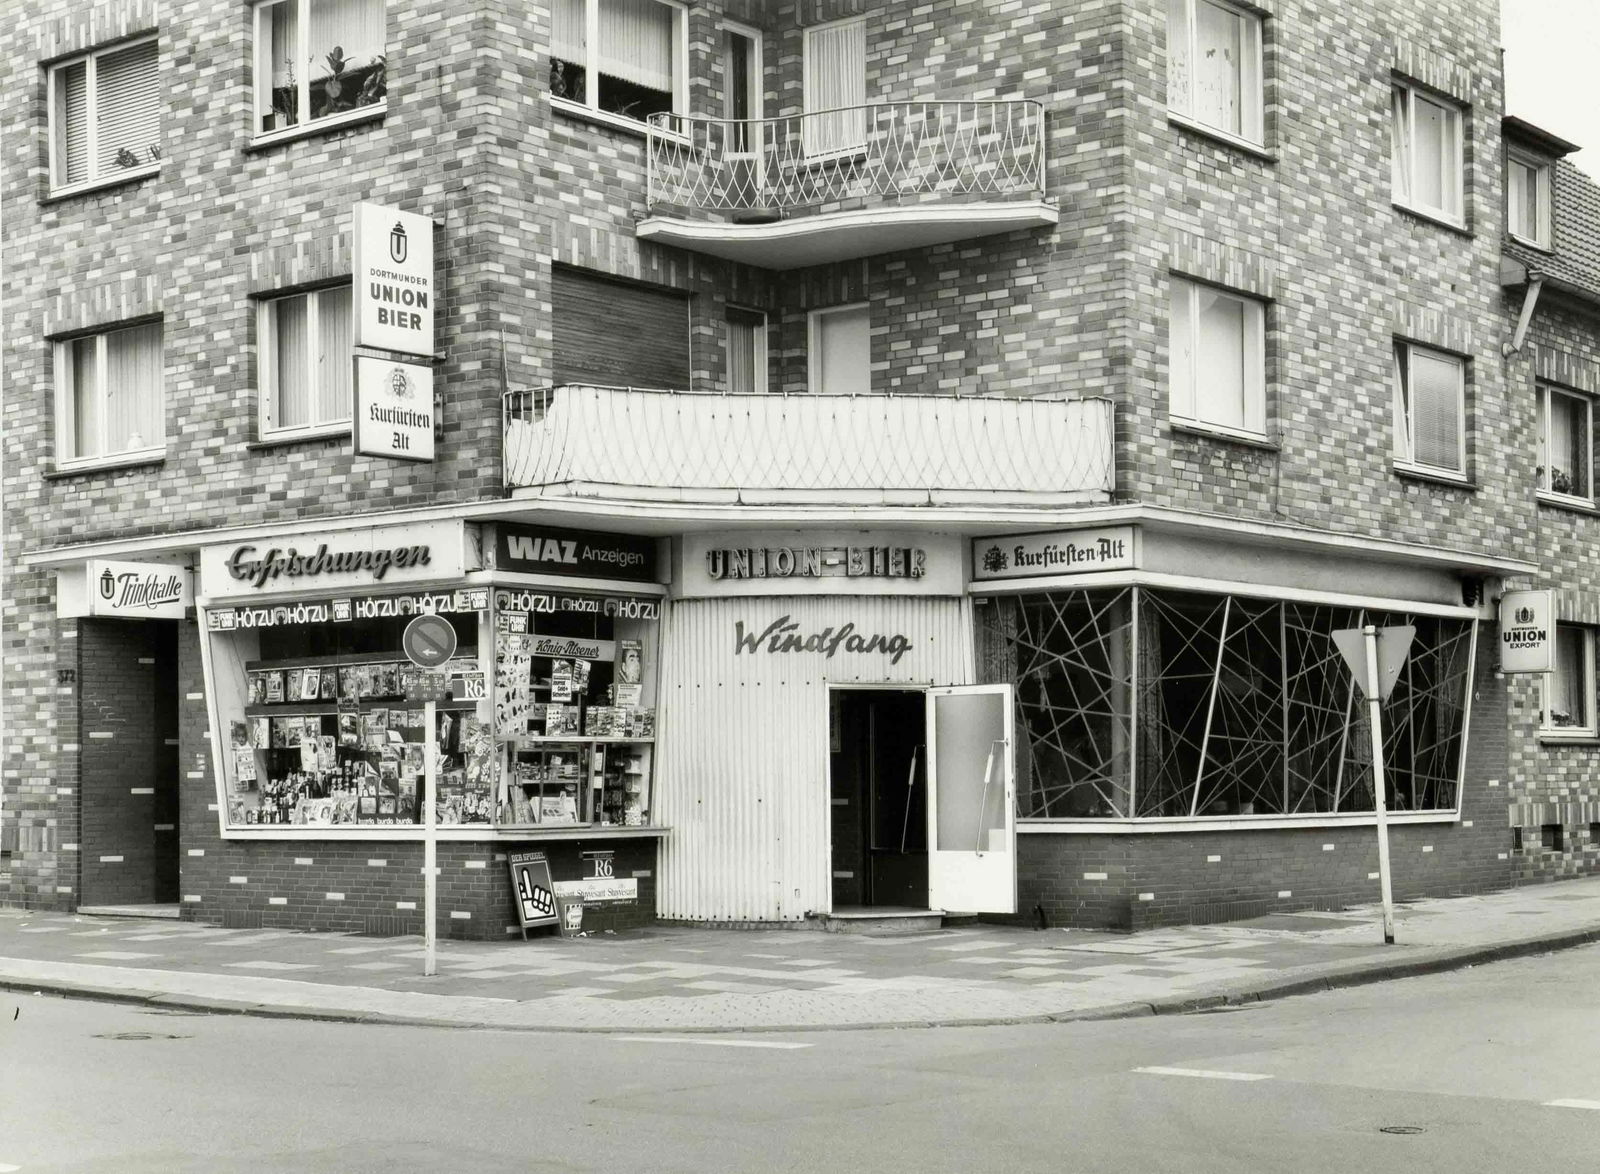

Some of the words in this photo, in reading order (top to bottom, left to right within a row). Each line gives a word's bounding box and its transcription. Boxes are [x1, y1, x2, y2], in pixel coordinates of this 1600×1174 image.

[370, 268, 428, 286] DORTMUNDER
[370, 282, 428, 309] UNION
[378, 307, 422, 331] BIER
[392, 431, 410, 451] Alt
[507, 535, 578, 564] WAZ
[582, 545, 644, 567] Anzeigen
[1097, 537, 1124, 562] Alt
[224, 544, 432, 588] Erfrischungen
[112, 573, 183, 609] Trinkhalle
[509, 615, 526, 625] FUNK
[511, 623, 525, 633] UHR
[735, 615, 913, 665] Windfang
[1503, 631, 1546, 642] UNION
[464, 679, 484, 698] R6
[523, 851, 546, 862] SPIEGEL
[594, 859, 613, 878] R6
